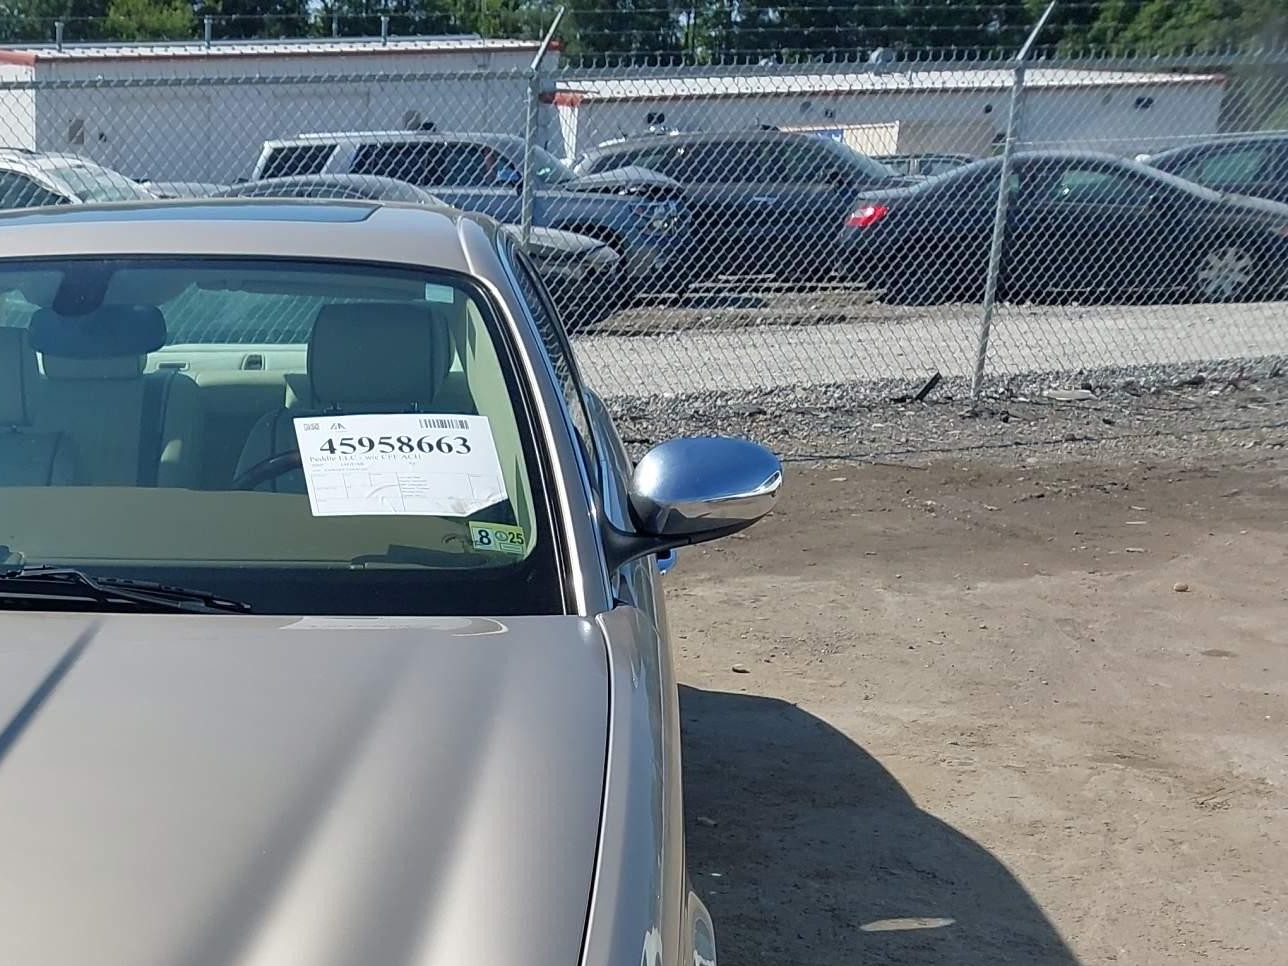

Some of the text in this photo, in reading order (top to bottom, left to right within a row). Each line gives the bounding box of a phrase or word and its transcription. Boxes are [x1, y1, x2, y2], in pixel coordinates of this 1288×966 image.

[319, 434, 472, 455] 45958663
[478, 529, 524, 546] 8 25
